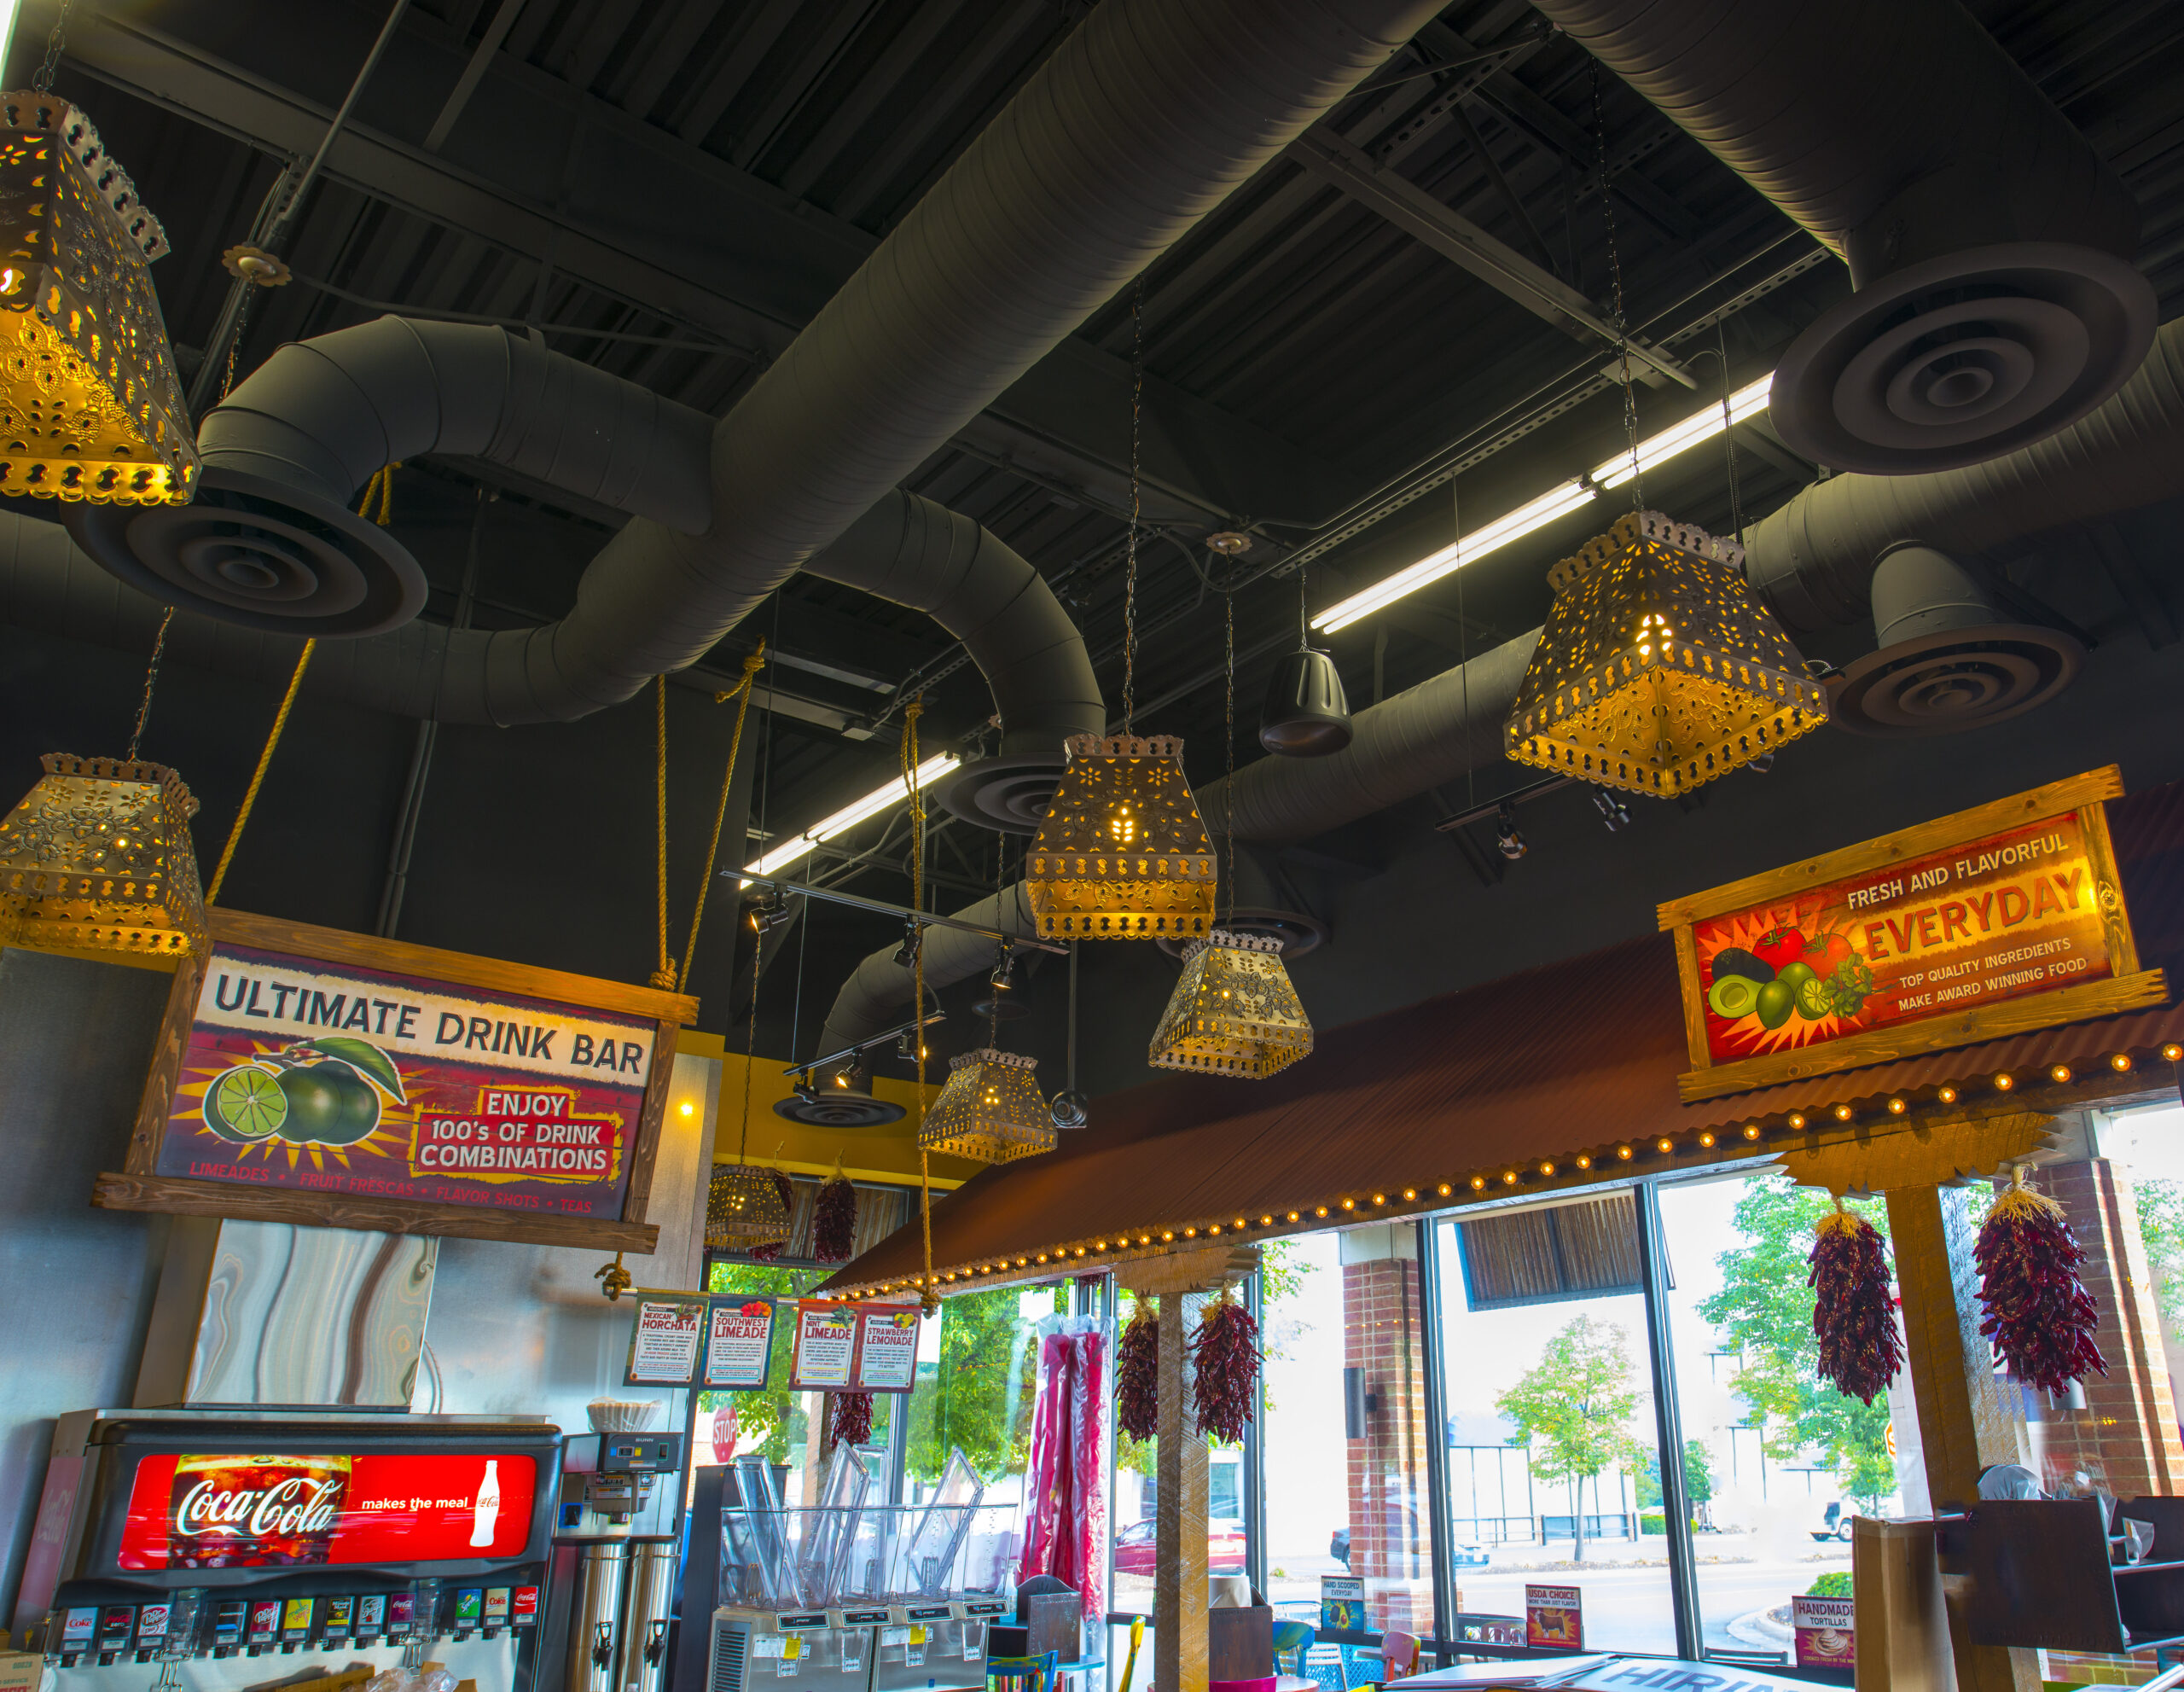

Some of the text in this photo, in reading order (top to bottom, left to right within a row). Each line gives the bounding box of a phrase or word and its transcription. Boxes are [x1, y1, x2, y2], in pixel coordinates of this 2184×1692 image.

[1847, 833, 2069, 910] FRESH AND FLAVORFUL
[1863, 867, 2083, 962] EVERYDAY
[1899, 937, 2071, 989] TOP QUALITY INGREDIENTS
[1898, 957, 2087, 1012] MAKE AWARD WINNING FOOD
[214, 974, 644, 1074] ULTIMATE DRINK BAR
[487, 1090, 567, 1117] ENJOY
[432, 1119, 601, 1146] 100's OF DRINK
[421, 1145, 607, 1171] COMBINATIONS
[189, 1161, 592, 1213] LIMEADES FRUIT FRESCAS FLAVOR SHOTS TEAS
[642, 1319, 696, 1331] HORCHATA
[717, 1317, 767, 1326] SOUTHWEST
[715, 1326, 767, 1339] LIMEADE
[804, 1327, 851, 1340] LIMEADE
[867, 1335, 913, 1346] LEMONADE
[868, 1328, 914, 1336] STRAWBERRY
[714, 1418, 736, 1444] STOP
[177, 1478, 344, 1536] Coca-Cola
[362, 1497, 468, 1512] makes the meal
[1528, 1590, 1575, 1599] USDA CHOICE
[1798, 1603, 1853, 1616] HANDMADE
[69, 1619, 92, 1627] Coke
[1809, 1617, 1847, 1626] TORTILLAS
